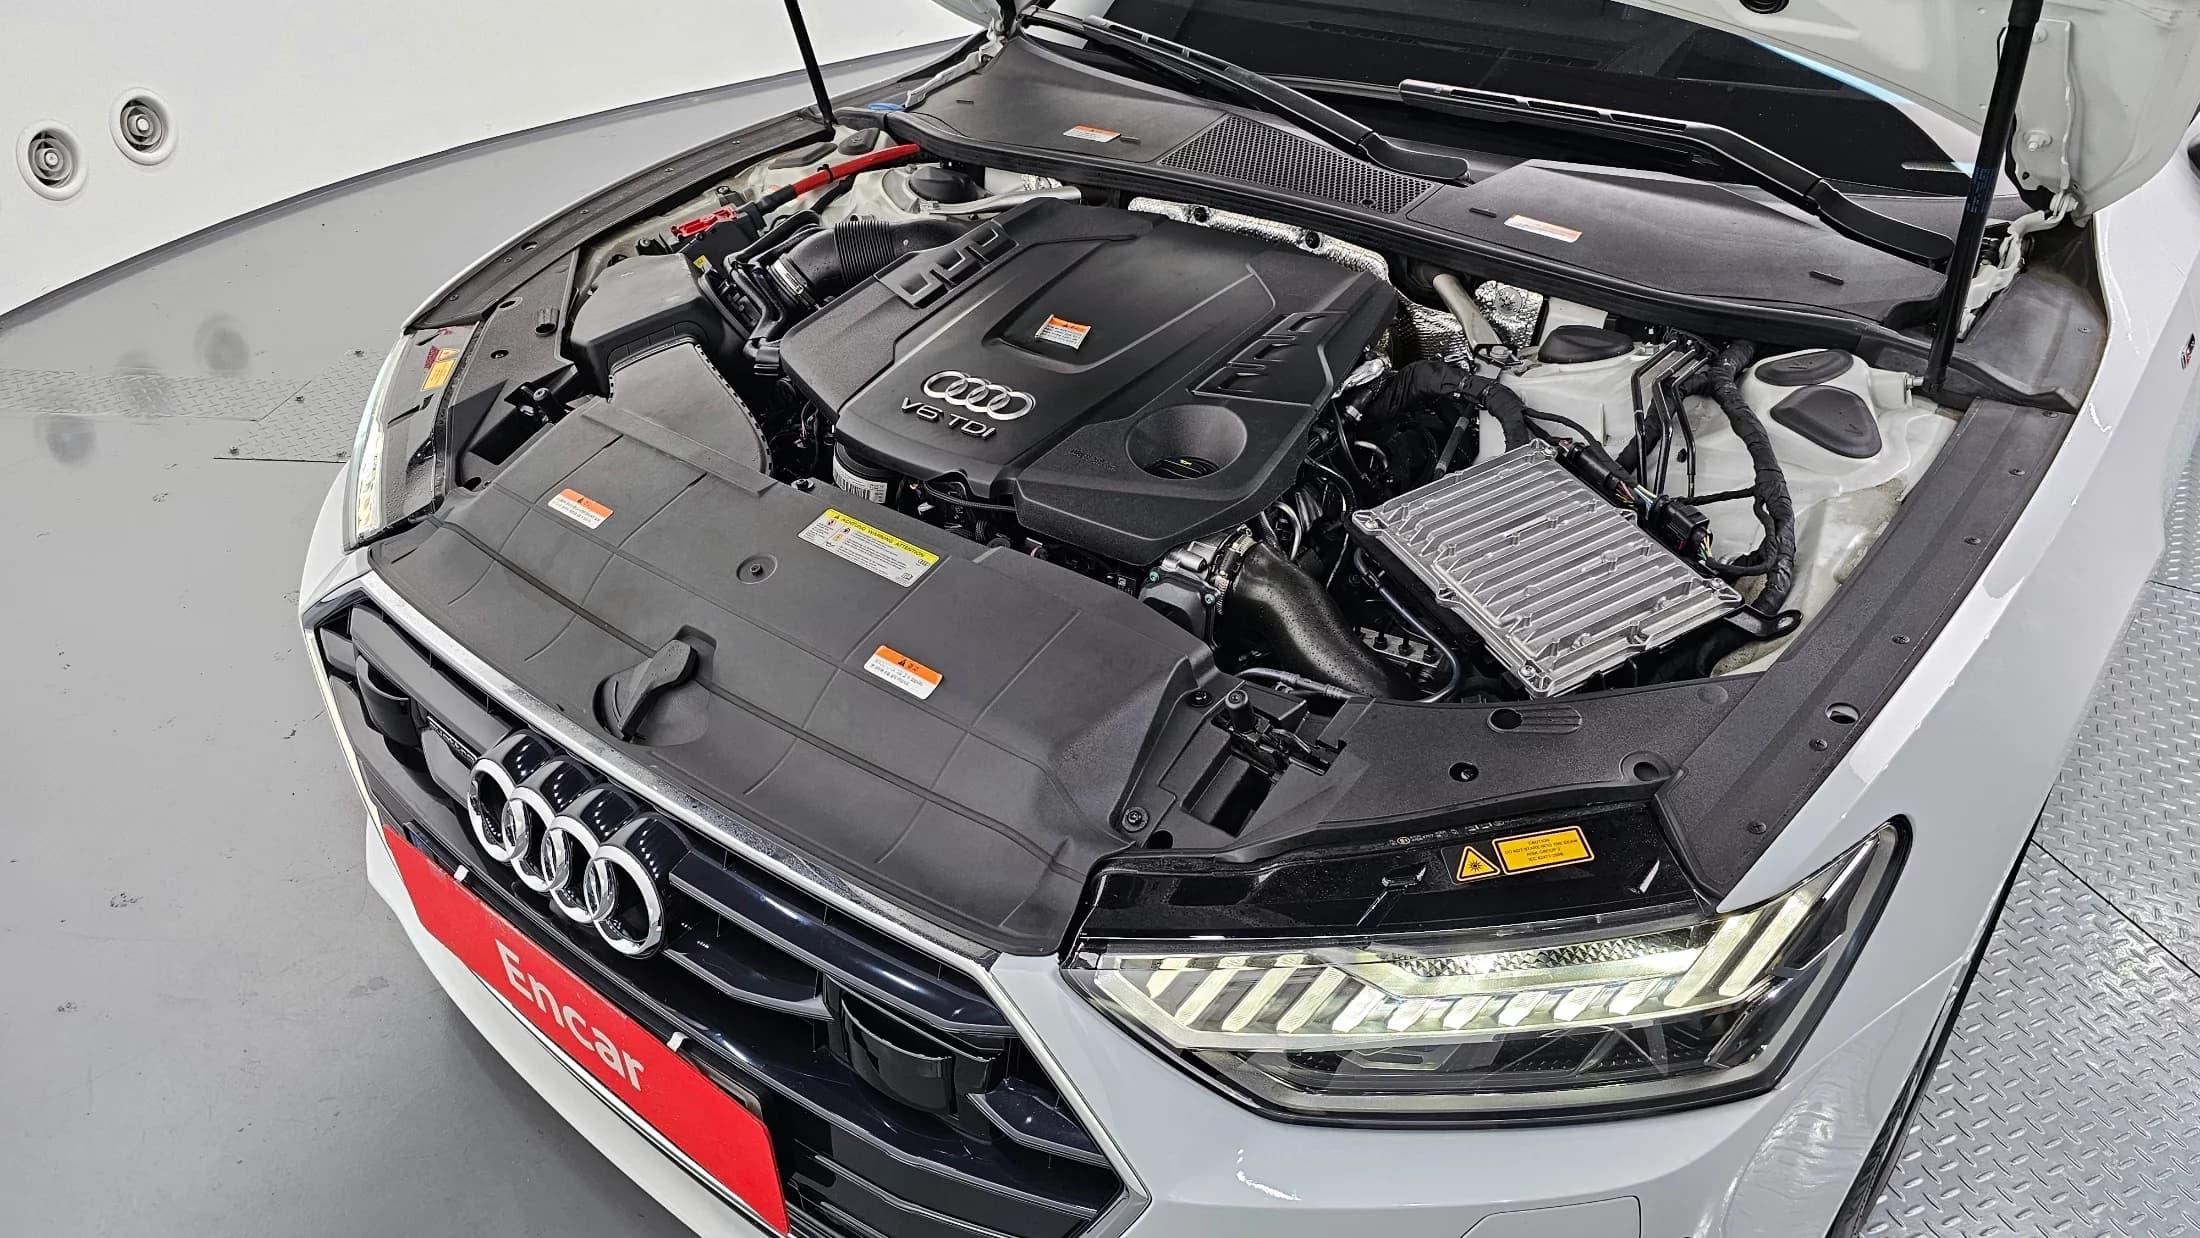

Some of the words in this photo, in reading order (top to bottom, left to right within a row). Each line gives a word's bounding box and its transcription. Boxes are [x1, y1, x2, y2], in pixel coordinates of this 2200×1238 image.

[901, 397, 944, 421] V6
[948, 413, 997, 438] TDI
[841, 517, 867, 532] ACHTUNG
[867, 529, 893, 544] WARNING
[895, 540, 926, 557] ATTENTION
[495, 938, 645, 1092] Encar
